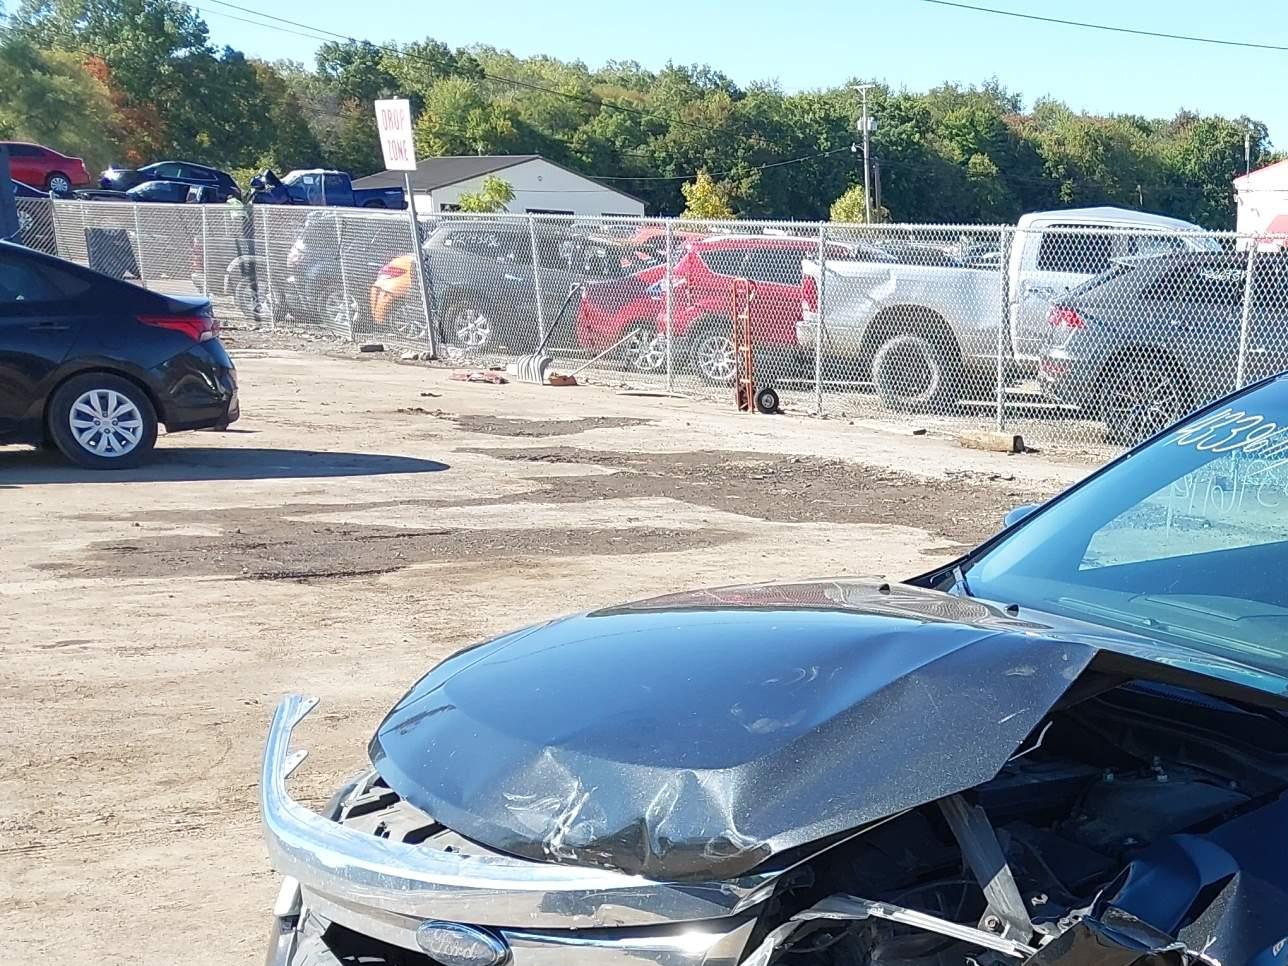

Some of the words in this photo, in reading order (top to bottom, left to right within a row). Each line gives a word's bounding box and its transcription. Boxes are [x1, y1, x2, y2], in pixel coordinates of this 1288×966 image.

[381, 109, 405, 131] DROP
[387, 139, 409, 161] ZONE
[431, 929, 480, 959] Ford
